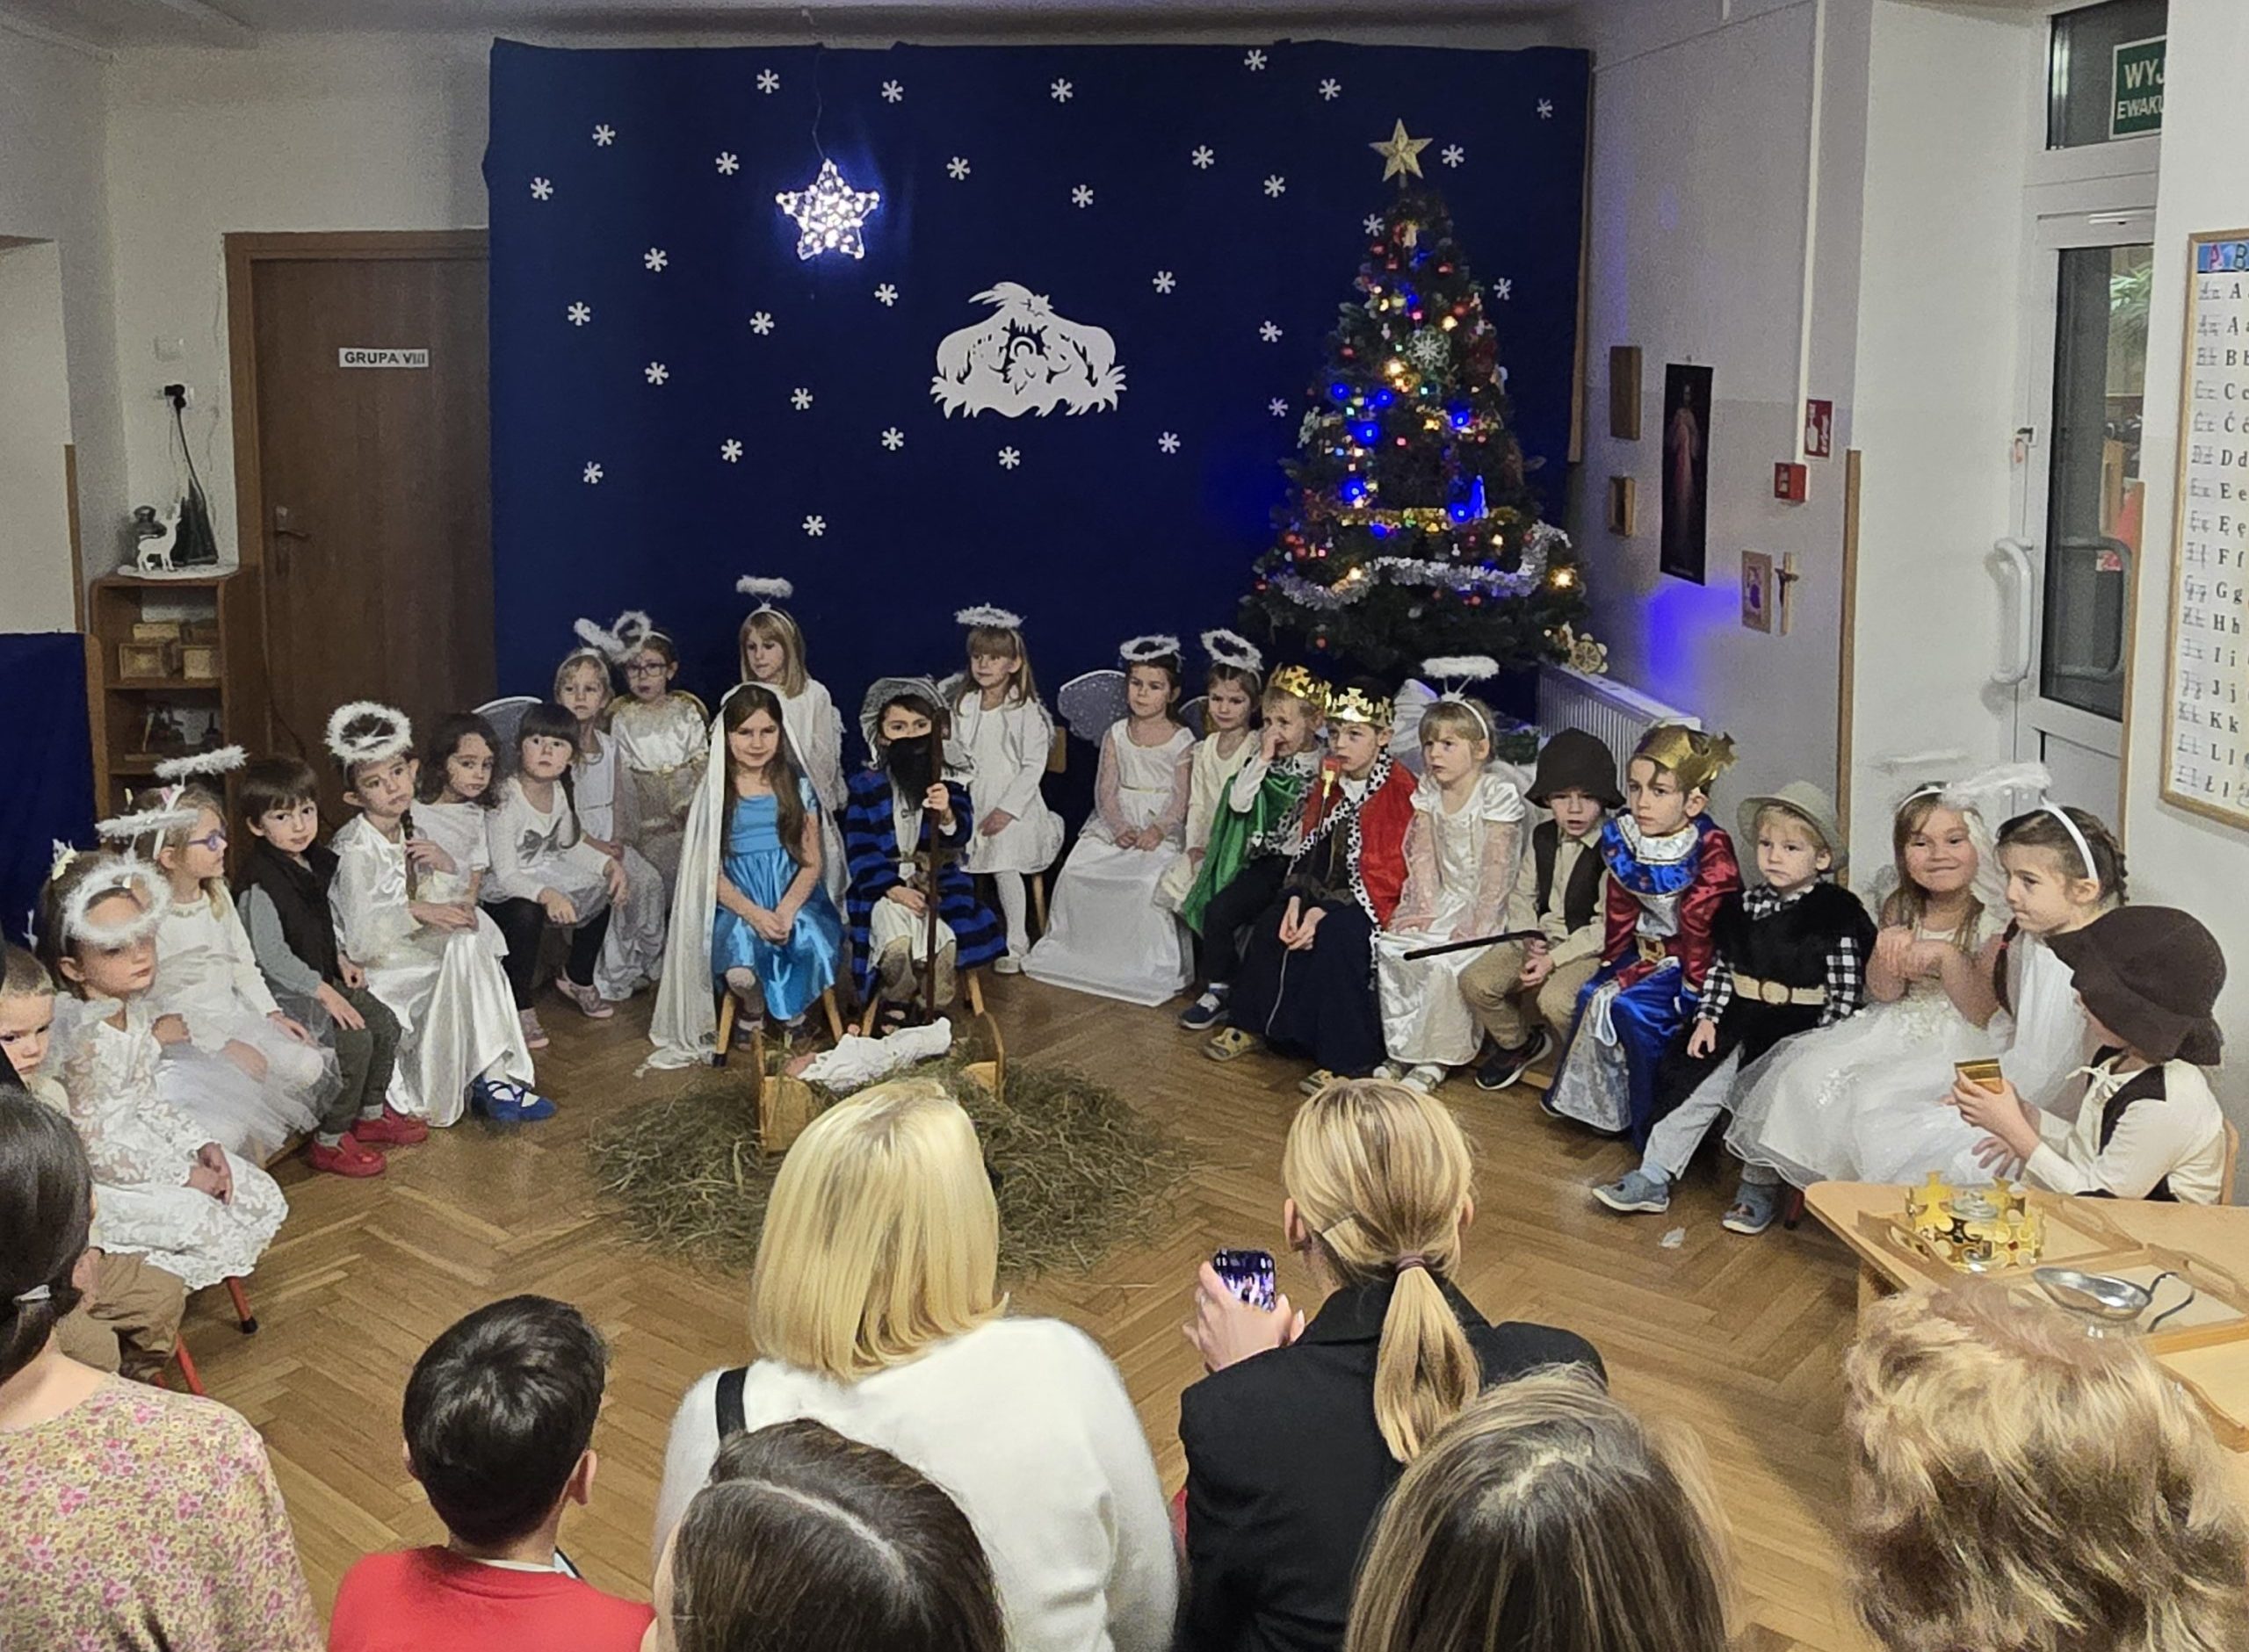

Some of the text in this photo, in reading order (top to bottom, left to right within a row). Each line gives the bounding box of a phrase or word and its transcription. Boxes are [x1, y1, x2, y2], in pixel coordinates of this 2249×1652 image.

[2229, 283, 2242, 299] A
[344, 351, 399, 364] GRUPA
[2225, 350, 2238, 365] B
[2224, 383, 2236, 400] C
[2221, 449, 2233, 466] D
[2238, 451, 2248, 467] d
[2220, 483, 2231, 499] E
[2238, 488, 2247, 501] e
[2218, 548, 2230, 565] F
[2216, 581, 2228, 598] G
[2233, 588, 2243, 605] g
[2213, 614, 2225, 631] H
[2231, 617, 2240, 634] h
[2230, 650, 2236, 667] i
[2212, 680, 2220, 696] J
[2229, 683, 2236, 703] j
[2209, 711, 2222, 730] K
[2229, 716, 2238, 733] k
[2211, 743, 2221, 761] L
